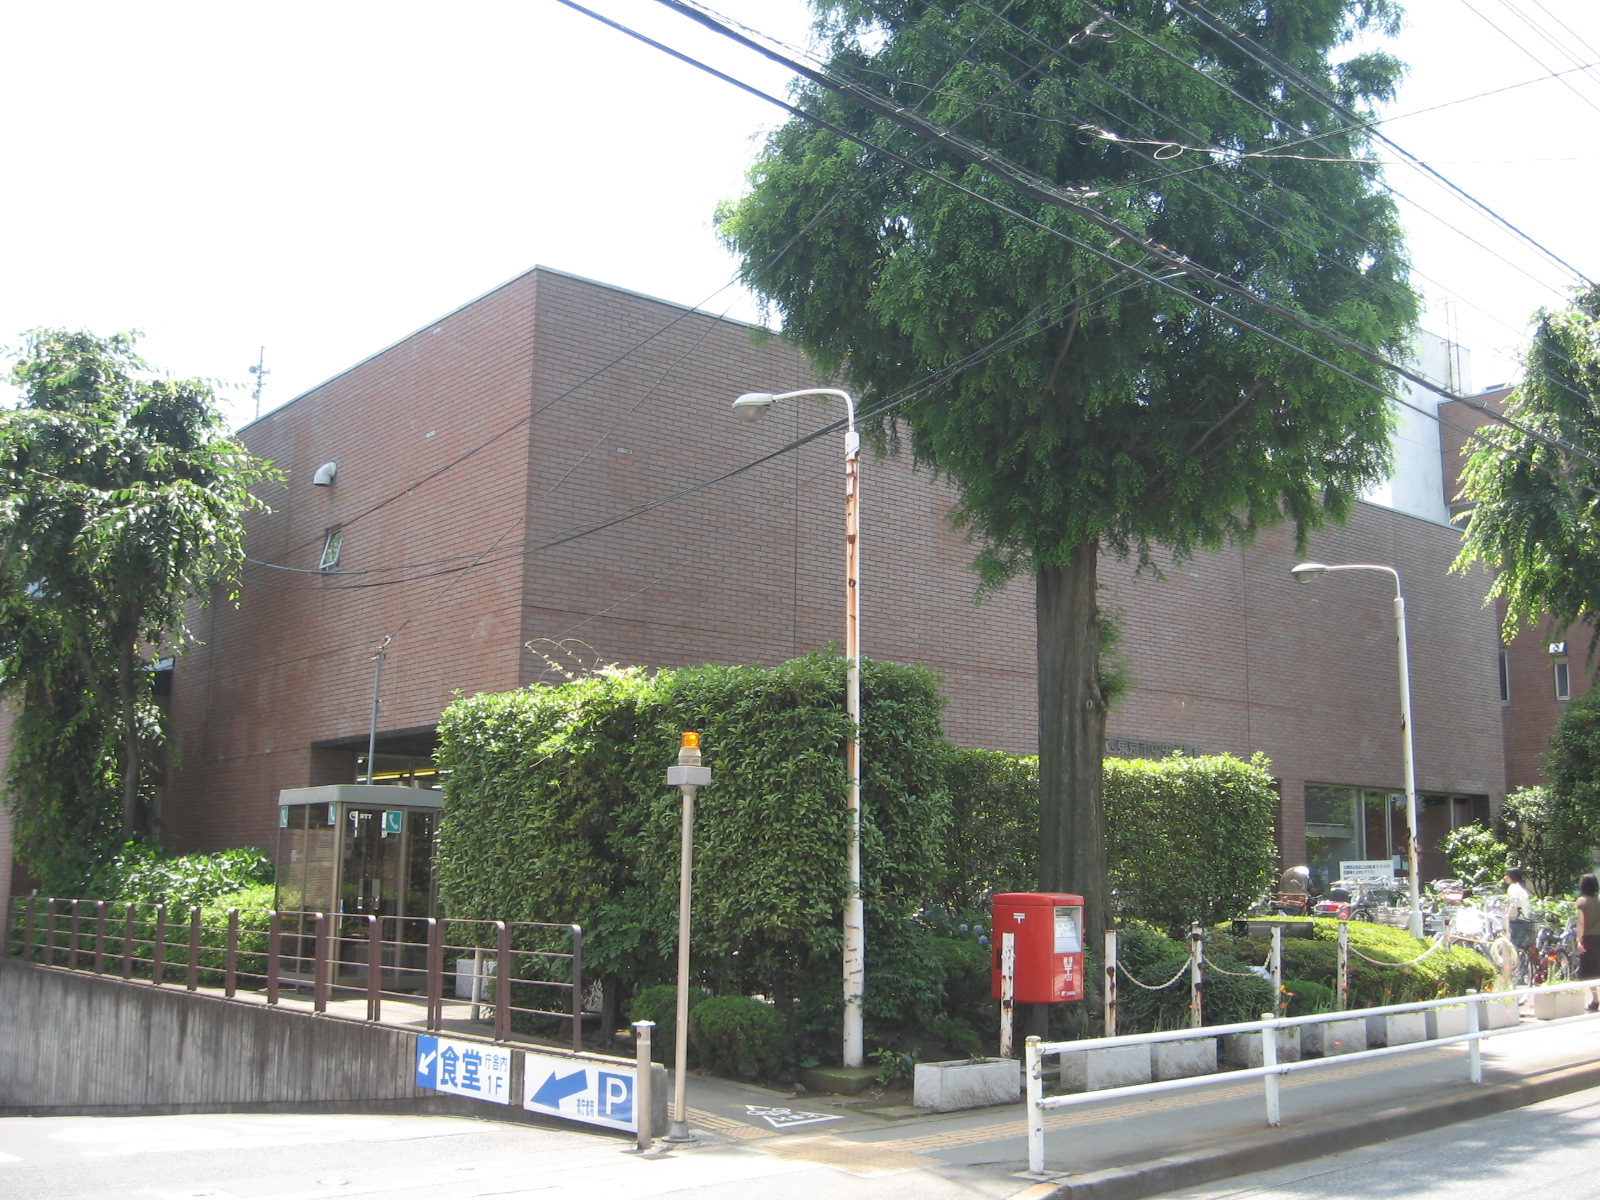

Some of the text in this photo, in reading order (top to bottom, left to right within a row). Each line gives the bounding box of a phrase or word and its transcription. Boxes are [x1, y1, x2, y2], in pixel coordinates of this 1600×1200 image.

[440, 1046, 482, 1091] 食堂
[485, 1053, 507, 1072] 庁舎内
[488, 1075, 503, 1095] 1F
[605, 1077, 628, 1115] P
